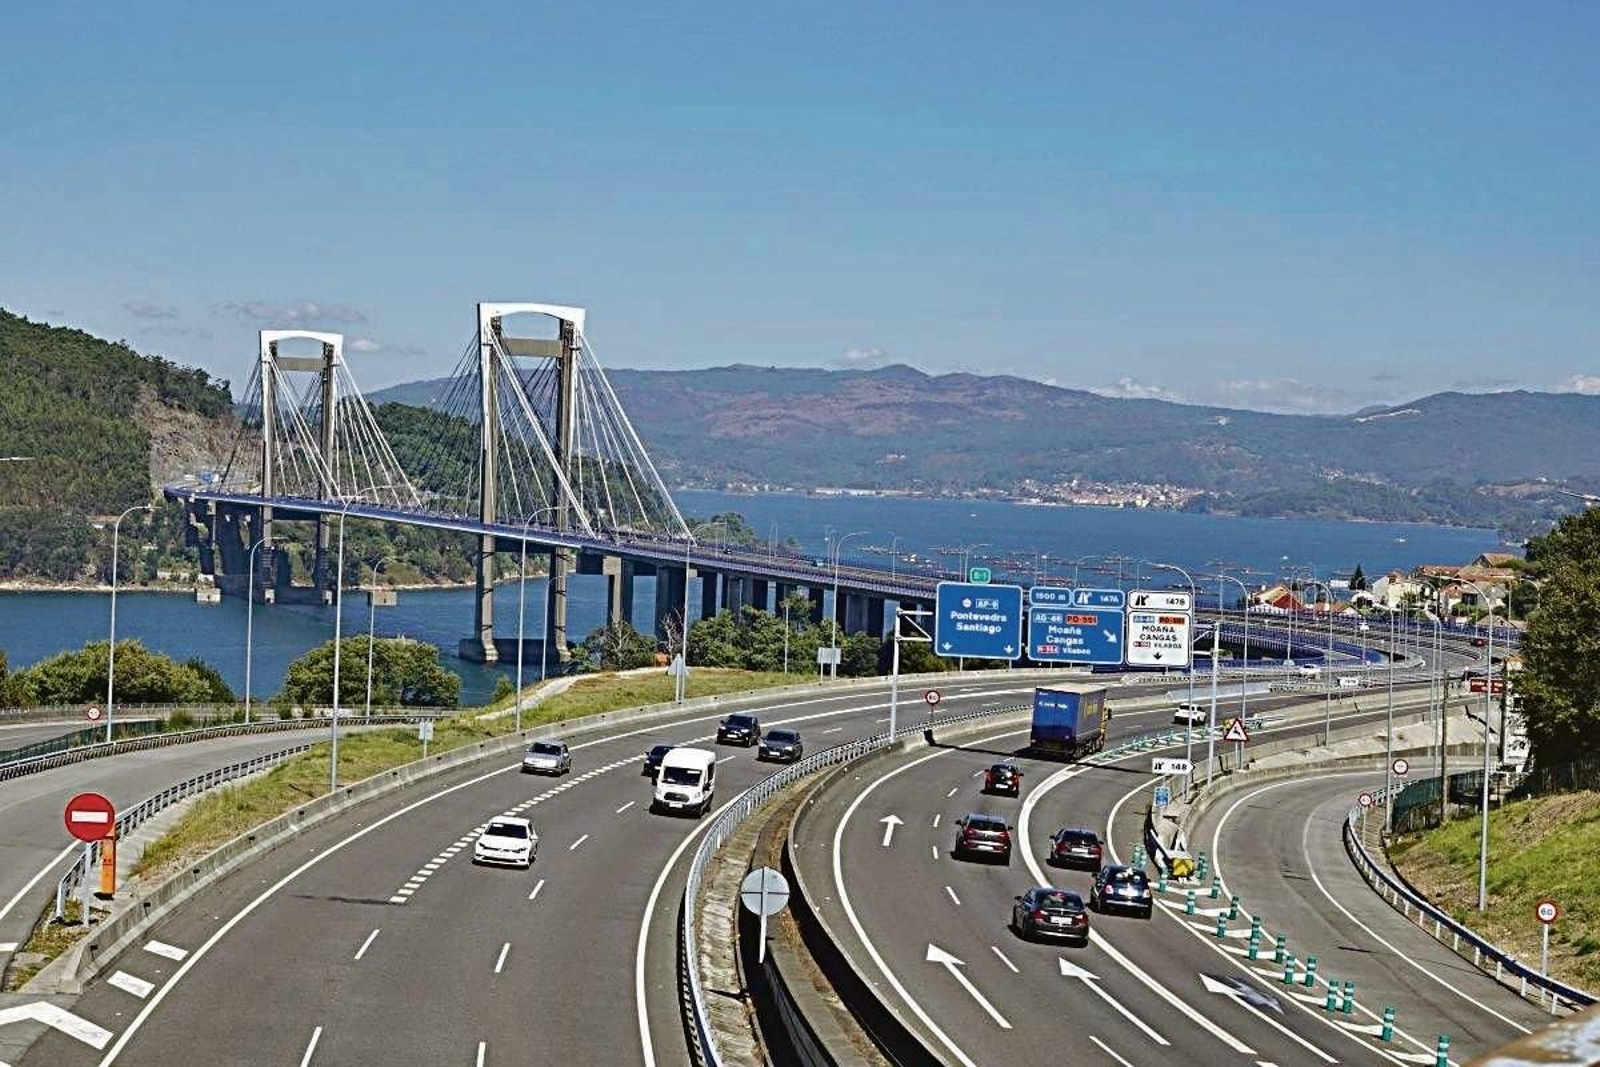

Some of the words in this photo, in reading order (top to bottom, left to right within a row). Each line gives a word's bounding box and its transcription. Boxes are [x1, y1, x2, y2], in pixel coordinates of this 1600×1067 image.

[1099, 595, 1120, 603] 147A
[950, 610, 1008, 622] Pontevedra
[956, 622, 1002, 634] Santiago
[1048, 625, 1082, 635] Moaña
[1045, 635, 1084, 646] Cangas
[1140, 633, 1177, 642] CANGAS
[1541, 907, 1553, 916] 60
